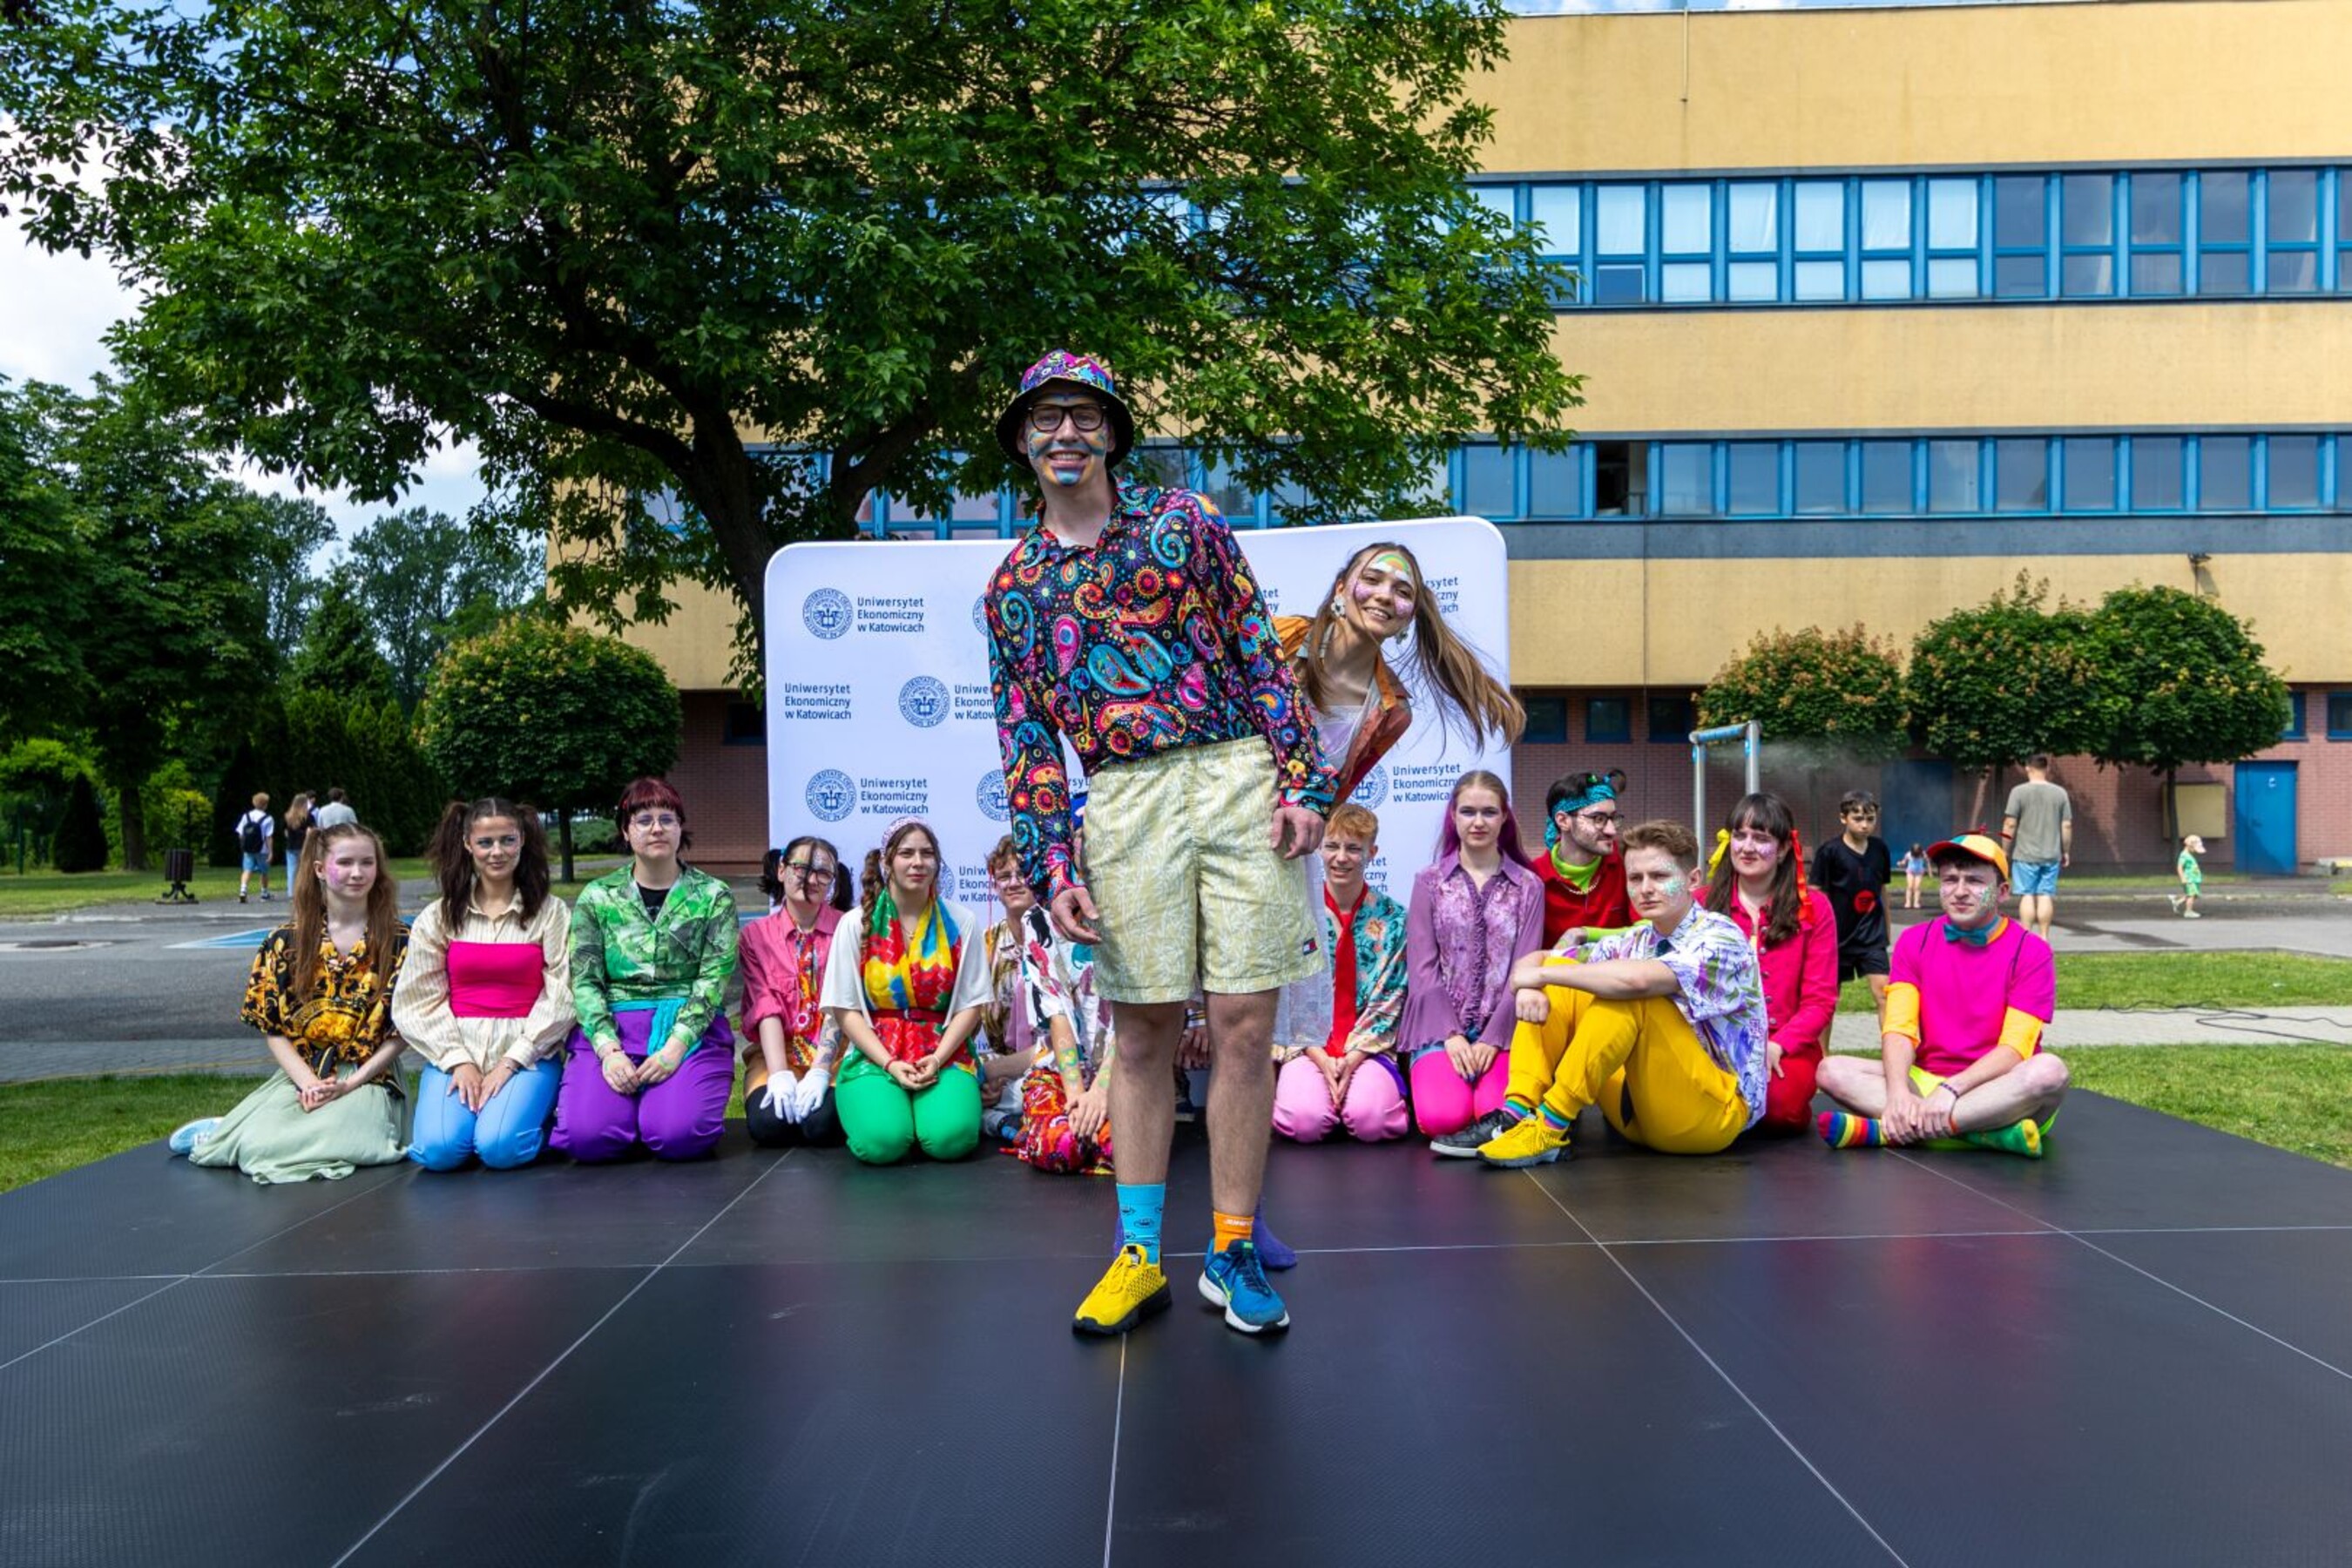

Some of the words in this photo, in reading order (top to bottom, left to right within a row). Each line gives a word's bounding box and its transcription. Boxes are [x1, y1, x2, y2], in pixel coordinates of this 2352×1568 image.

[857, 597, 923, 609] Uniwersytet
[857, 609, 924, 621] Ekonomiczny
[869, 622, 924, 632] Katowicach
[785, 682, 850, 695] Uniwersytet
[785, 696, 850, 708] Ekonomiczny
[797, 709, 851, 719] Katowicach
[1394, 764, 1460, 775] Uniwersytet
[861, 778, 927, 790] Uniwersytet
[861, 791, 928, 802] Ekonomiczny
[1405, 790, 1450, 801] Katowica
[873, 804, 929, 814] Katowicach
